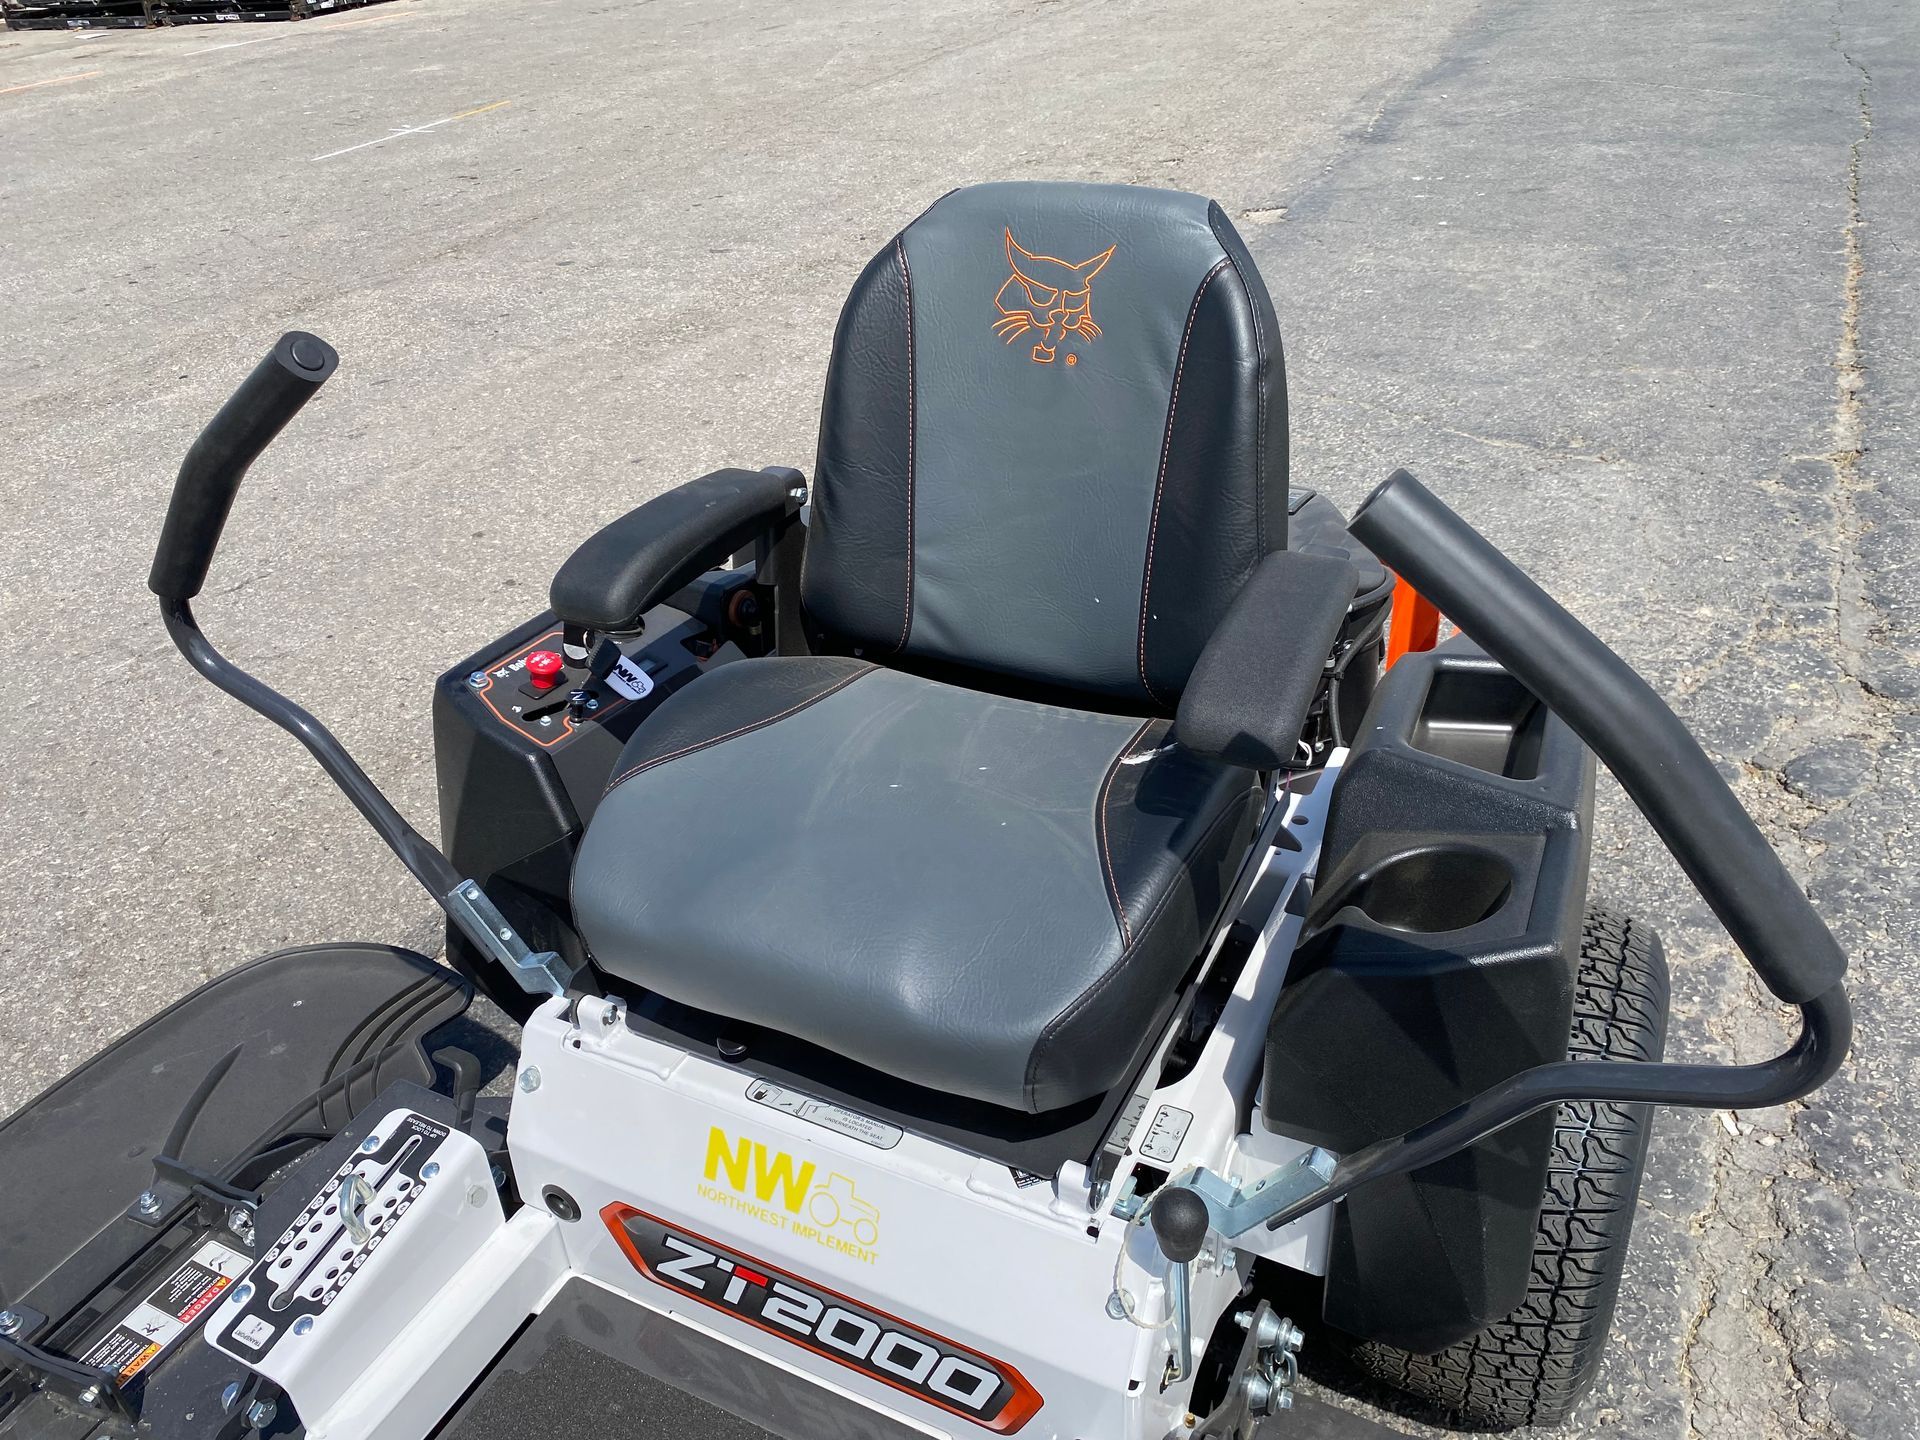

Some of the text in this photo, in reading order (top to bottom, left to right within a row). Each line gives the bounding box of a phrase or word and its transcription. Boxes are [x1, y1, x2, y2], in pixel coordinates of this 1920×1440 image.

[824, 1116, 859, 1132] UNDERNEATH
[870, 1132, 883, 1141] SEAT
[848, 1119, 873, 1131] LOCATED
[866, 1119, 886, 1129] MANUAL
[703, 1125, 816, 1215] NW
[697, 1183, 880, 1265] NORTHWEST IMPLEMENT
[197, 1276, 220, 1299] ROTATING
[177, 1298, 198, 1317] BLADES
[182, 1287, 219, 1321] DANGER
[656, 1236, 1002, 1411] ZT2000
[234, 1330, 261, 1348] TRANSPORT
[125, 1344, 150, 1366] THROWN
